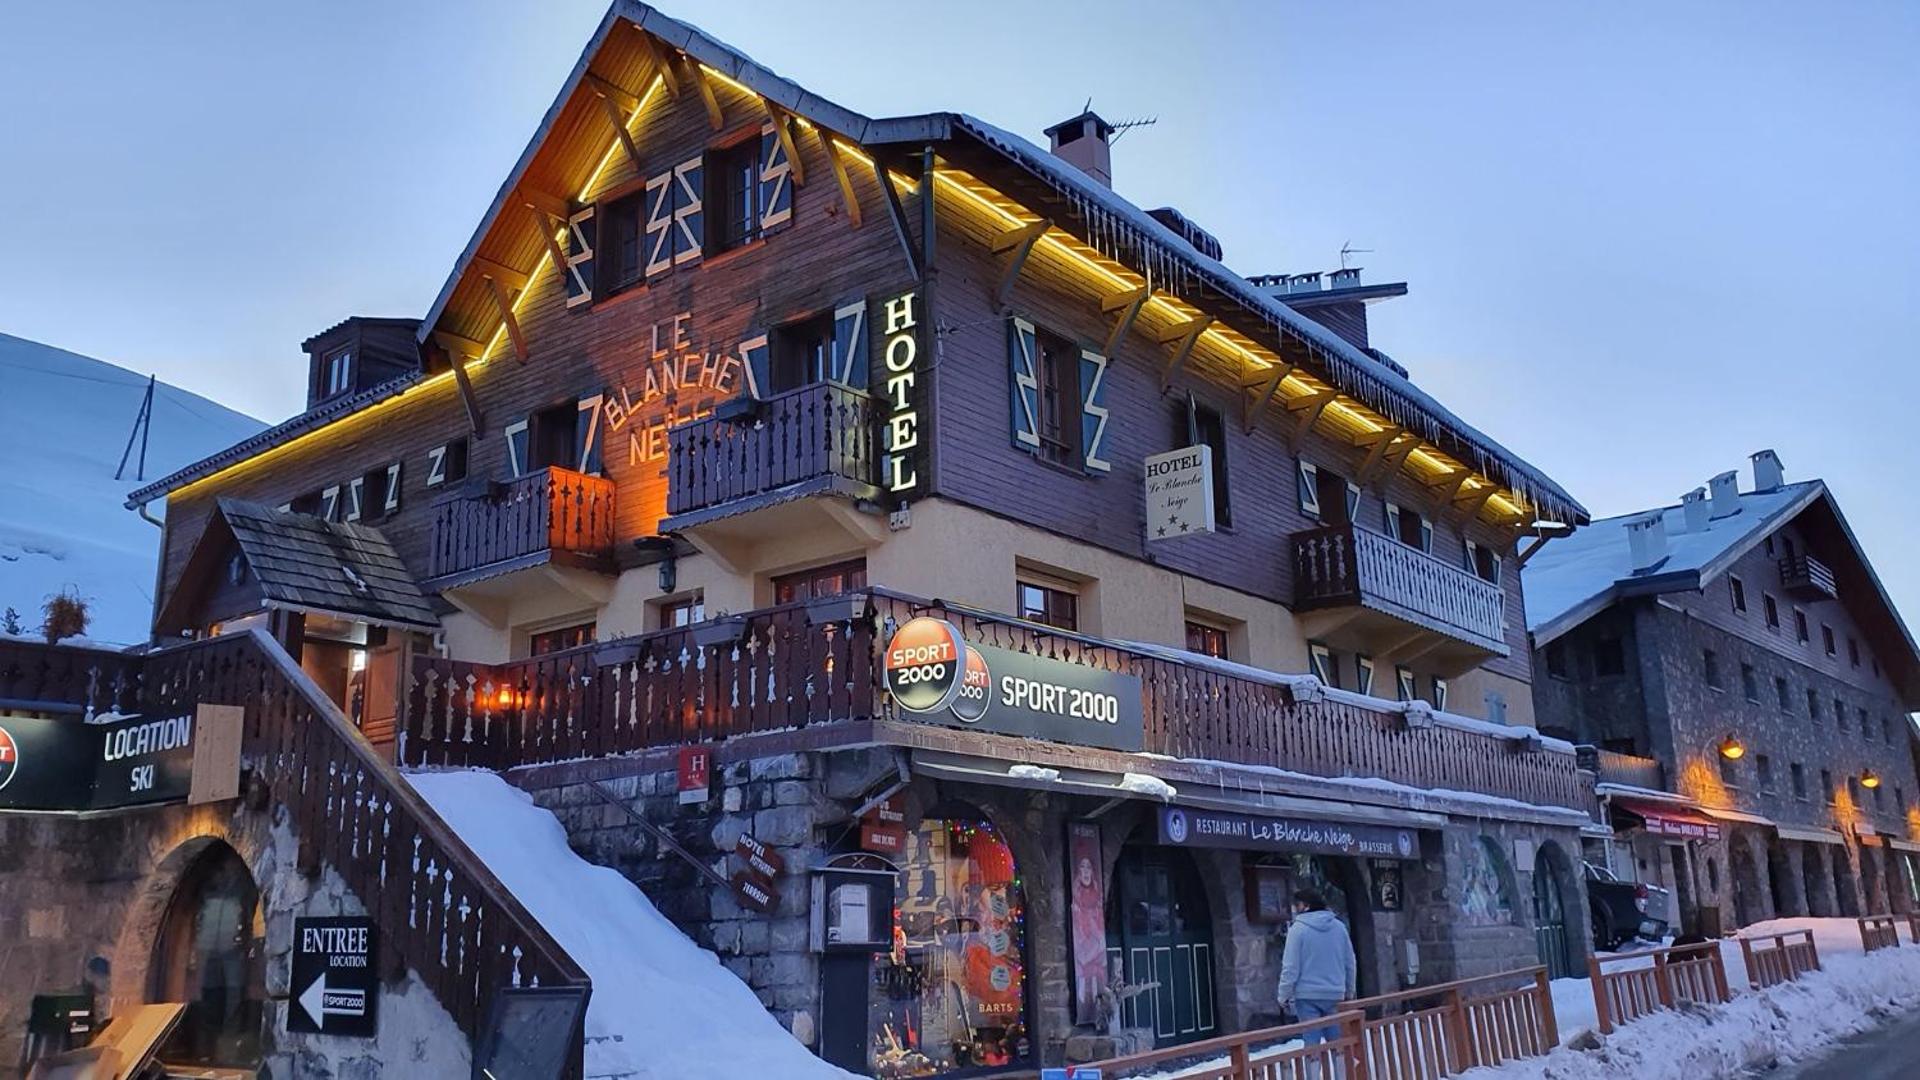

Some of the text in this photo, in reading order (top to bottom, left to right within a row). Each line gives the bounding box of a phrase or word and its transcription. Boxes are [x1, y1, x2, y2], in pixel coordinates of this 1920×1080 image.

[652, 311, 692, 358] LE
[604, 352, 741, 431] BLANCHE
[884, 293, 918, 492] HOTEL
[1146, 454, 1203, 478] HOTEL
[893, 643, 950, 666] SPORT
[898, 663, 946, 685] 2000
[965, 669, 986, 685] ORT
[960, 684, 983, 699] 000
[1001, 675, 1119, 724] SPORT 2000
[104, 715, 192, 762] LOCATION
[692, 754, 705, 772] H
[130, 764, 154, 792] SKI
[1196, 818, 1247, 836] RESTAURANT
[1251, 820, 1271, 840] Le
[1273, 821, 1322, 843] Blanche
[1324, 827, 1355, 852] Neige
[302, 927, 368, 953] ENTREE
[329, 955, 367, 967] LOCATION
[978, 1003, 1013, 1013] BARTS
